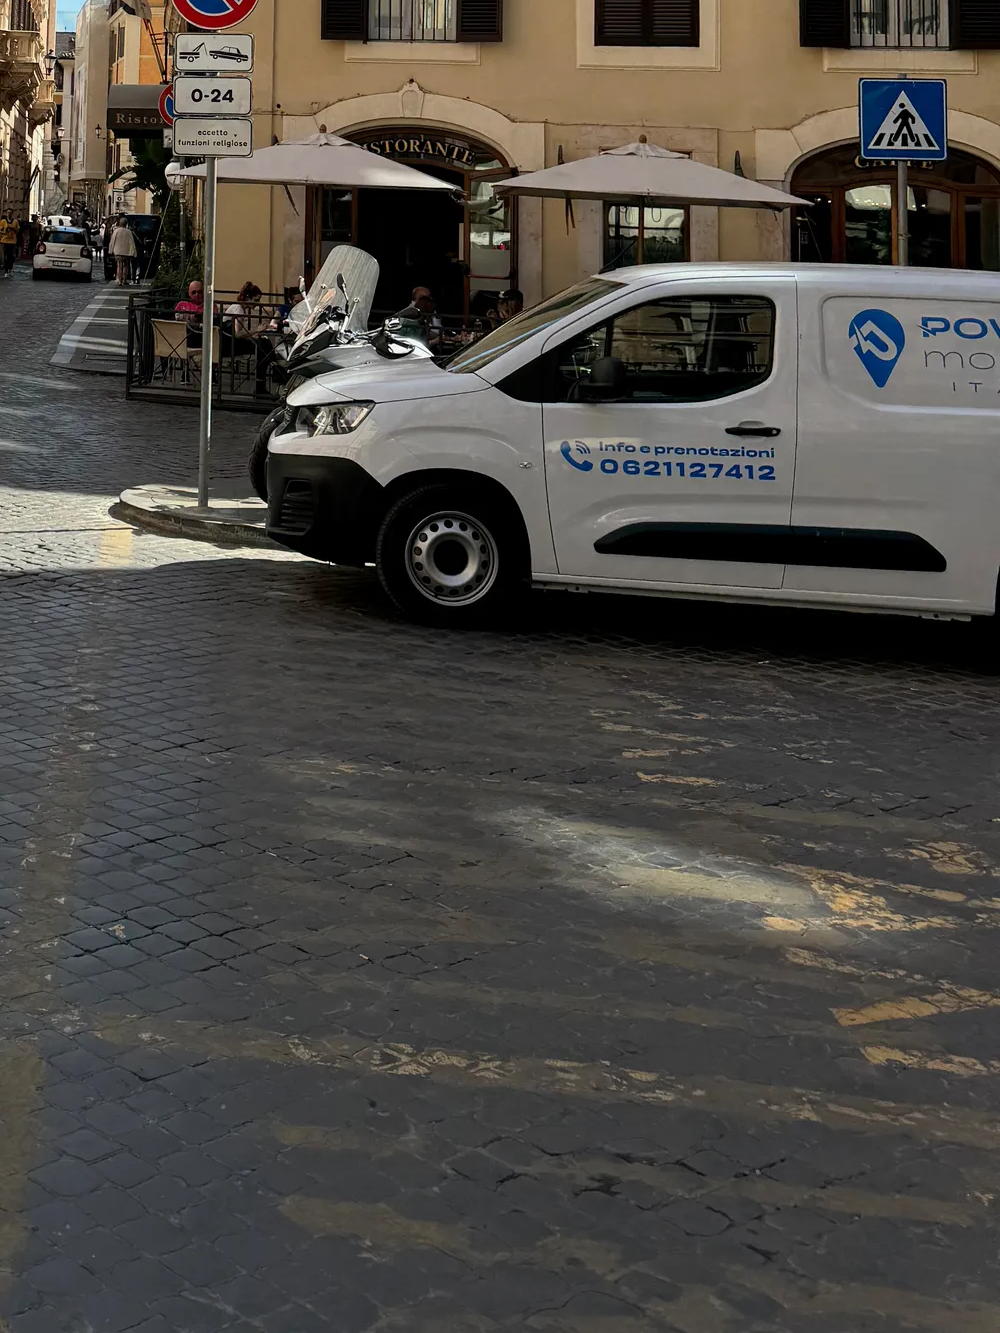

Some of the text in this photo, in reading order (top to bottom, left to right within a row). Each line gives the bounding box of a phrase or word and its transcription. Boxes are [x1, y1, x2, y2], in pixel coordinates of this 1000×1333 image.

[190, 88, 235, 103] 0-24
[213, 139, 248, 148] religiose
[952, 381, 1000, 393] IT
[640, 445, 651, 454] e
[654, 444, 775, 458] prenotazioni
[600, 458, 776, 481] 0621127412
